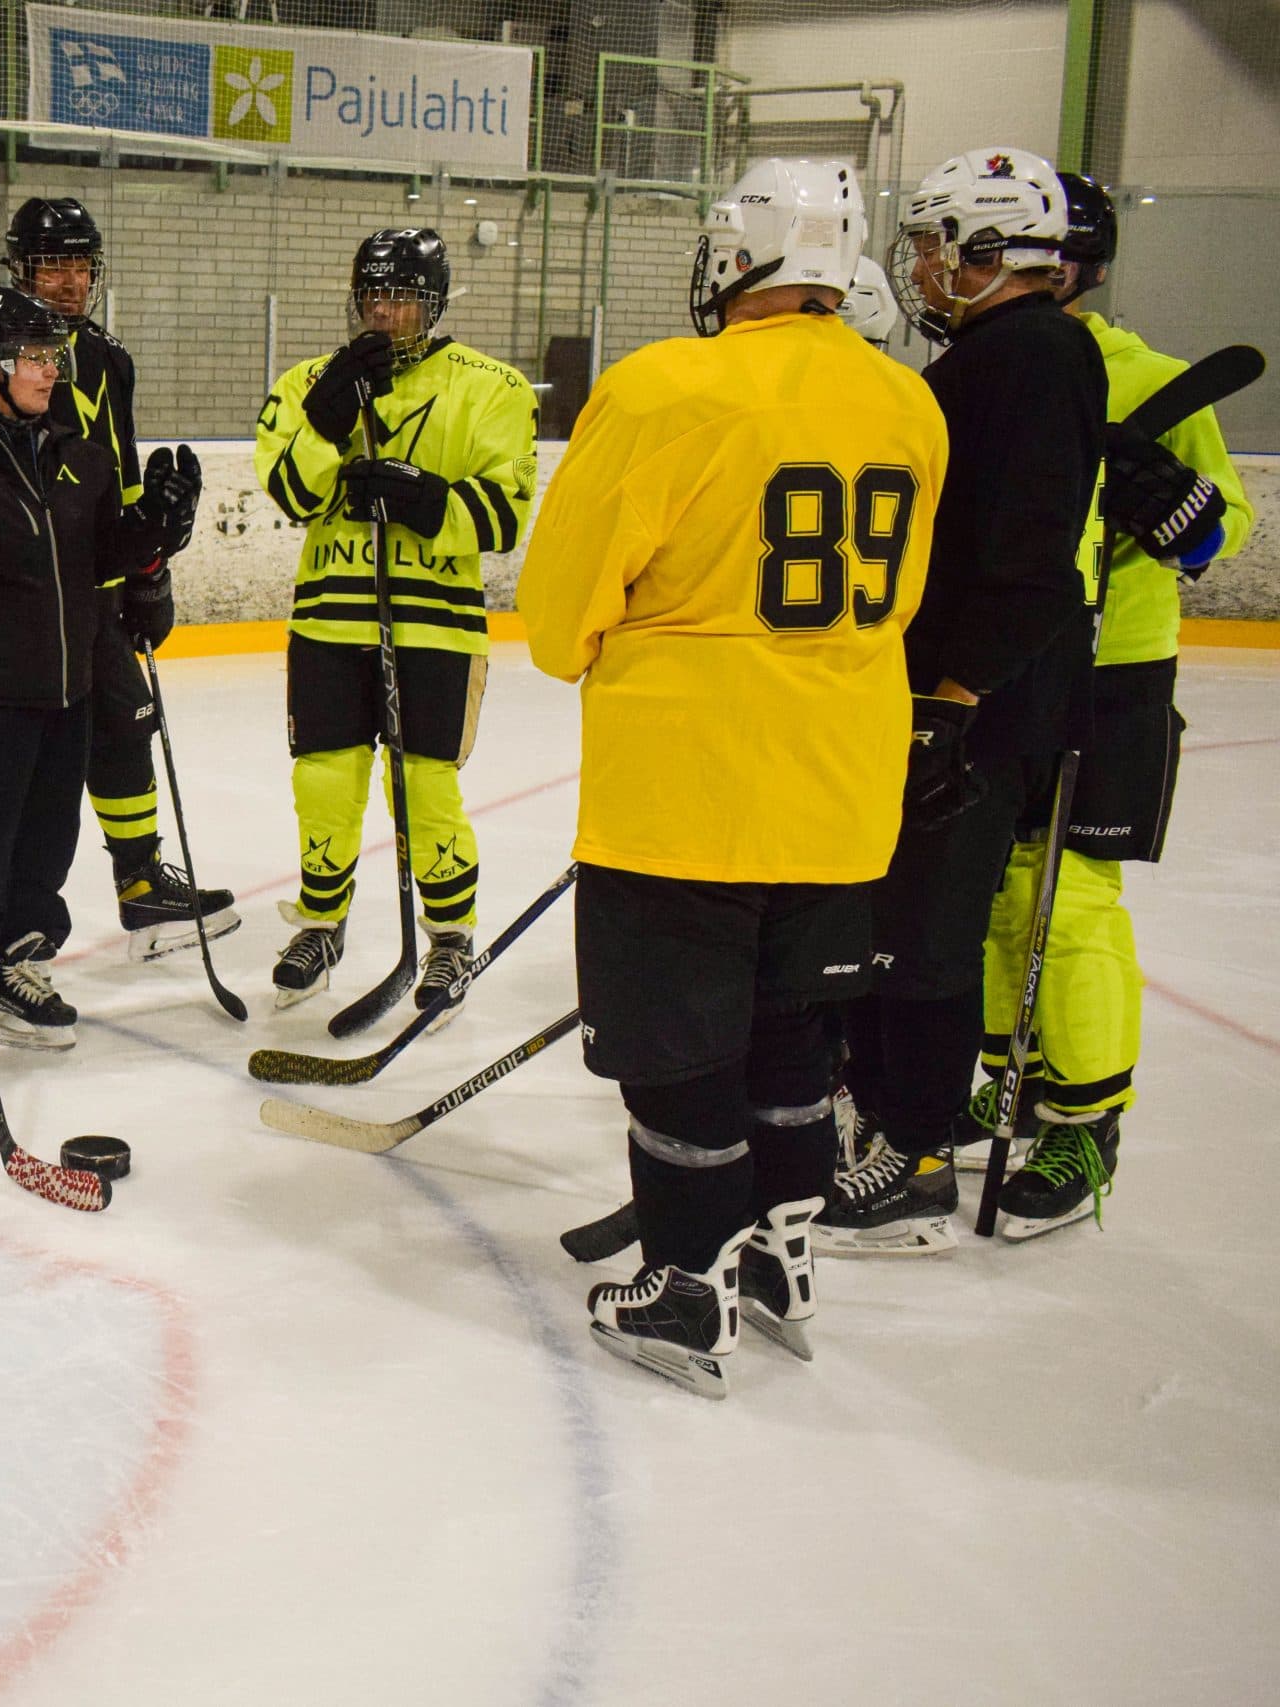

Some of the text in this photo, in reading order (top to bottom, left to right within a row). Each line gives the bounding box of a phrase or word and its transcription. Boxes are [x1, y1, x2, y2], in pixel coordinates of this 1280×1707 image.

[305, 65, 508, 138] Pajulahti
[739, 194, 772, 205] CCM
[975, 196, 1019, 204] BAUER
[754, 461, 920, 632] 89
[1068, 823, 1133, 837] BAUER
[1024, 951, 1043, 1008] TACKS
[432, 1047, 525, 1121] SUPREME
